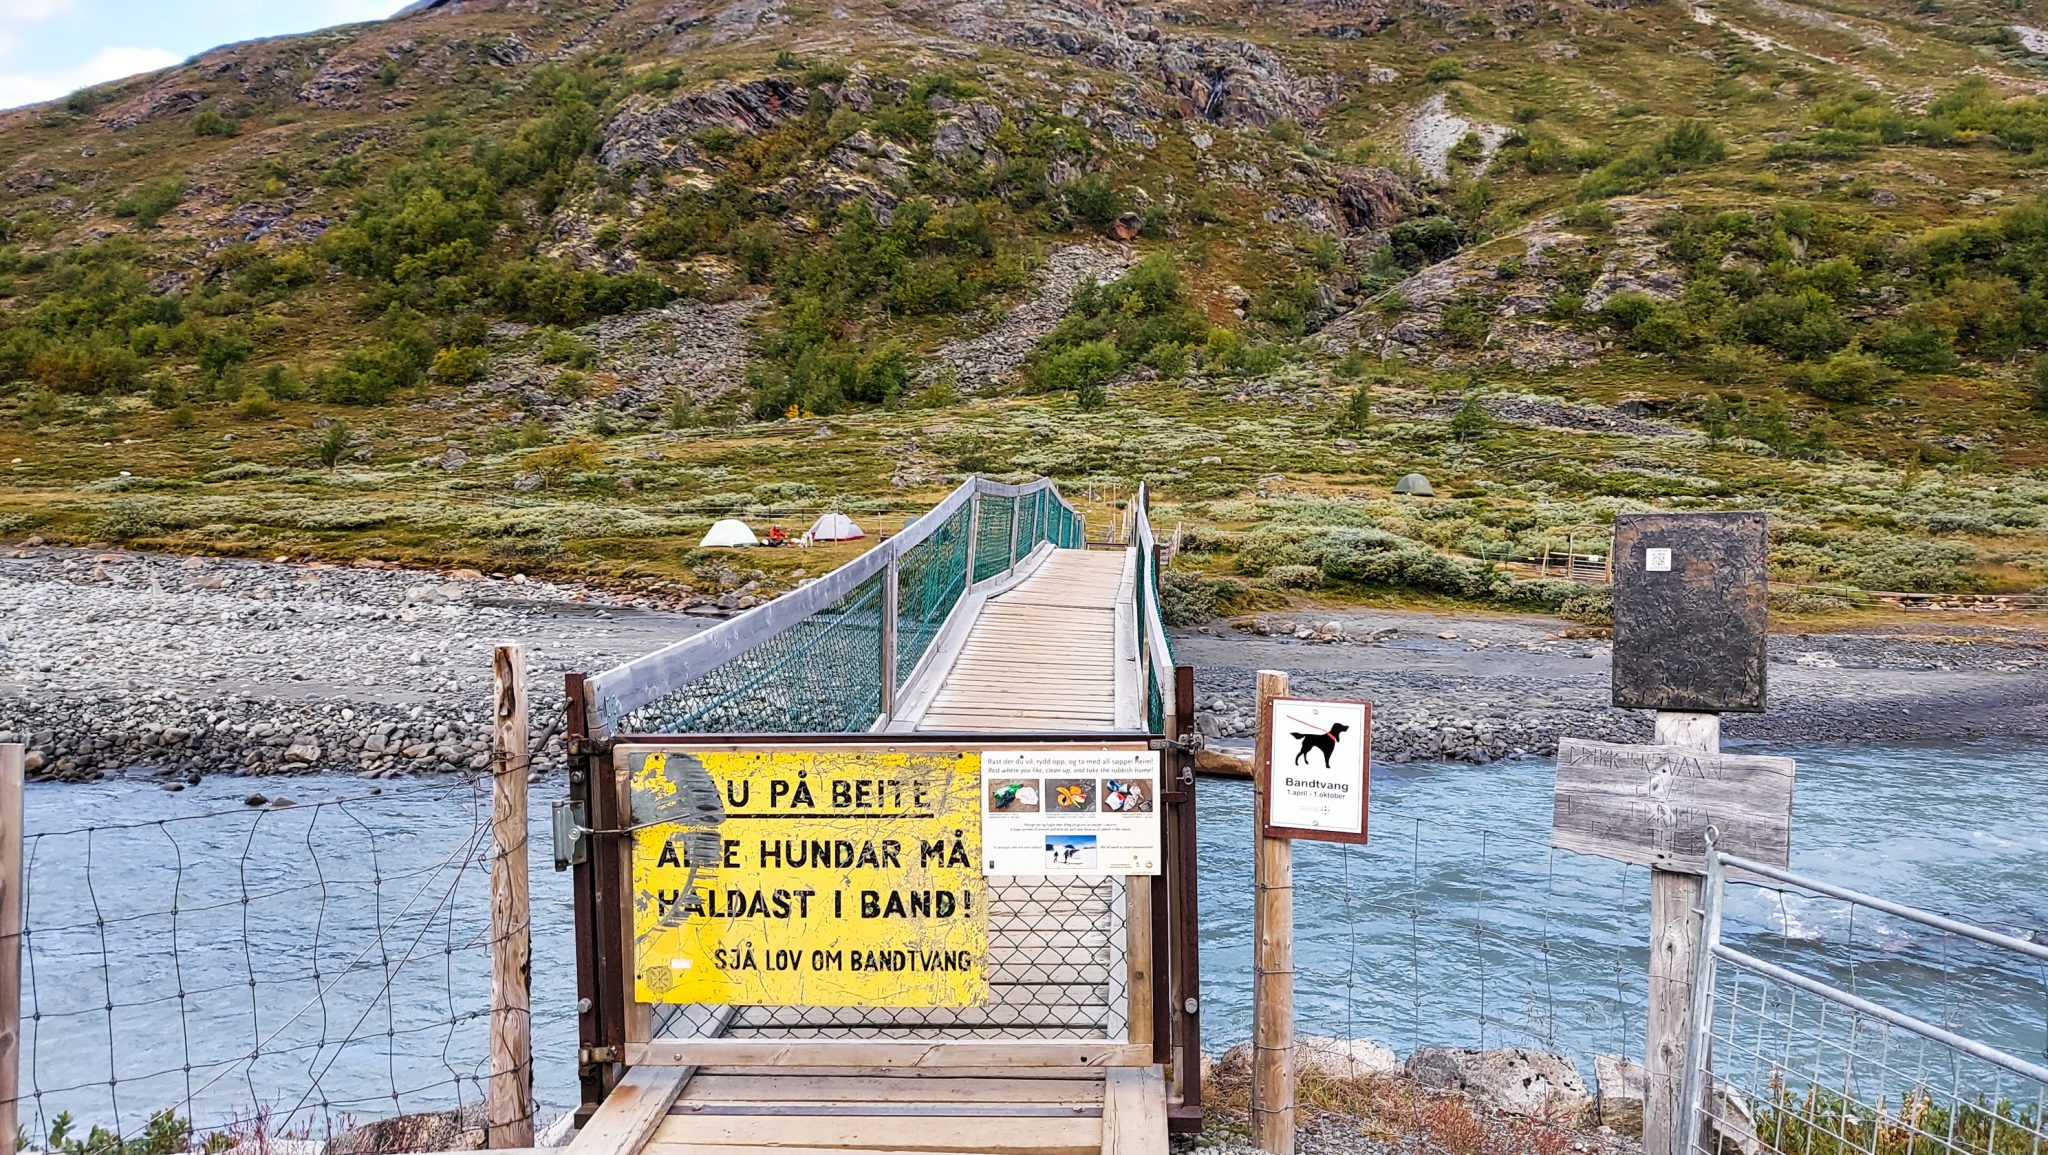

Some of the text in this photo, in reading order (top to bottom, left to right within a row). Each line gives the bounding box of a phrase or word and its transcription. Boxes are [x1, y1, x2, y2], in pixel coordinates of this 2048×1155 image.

[1003, 757, 1014, 765] der
[1015, 757, 1024, 765] du
[1036, 757, 1051, 766] rydd
[1068, 759, 1077, 767] og
[1111, 758, 1134, 766] søppel
[770, 769, 815, 808] PÅ
[832, 779, 931, 808] BEITE
[1285, 777, 1349, 793] Bandtvang
[1287, 789, 1308, 797] 1.april
[1313, 791, 1346, 799] 1.oktober
[760, 840, 901, 868] HUNDAR
[920, 829, 971, 868] MÅ
[658, 889, 972, 919] HALDAST I BAND!
[714, 941, 972, 972] SJÅ LOV OM BANDTVANG
